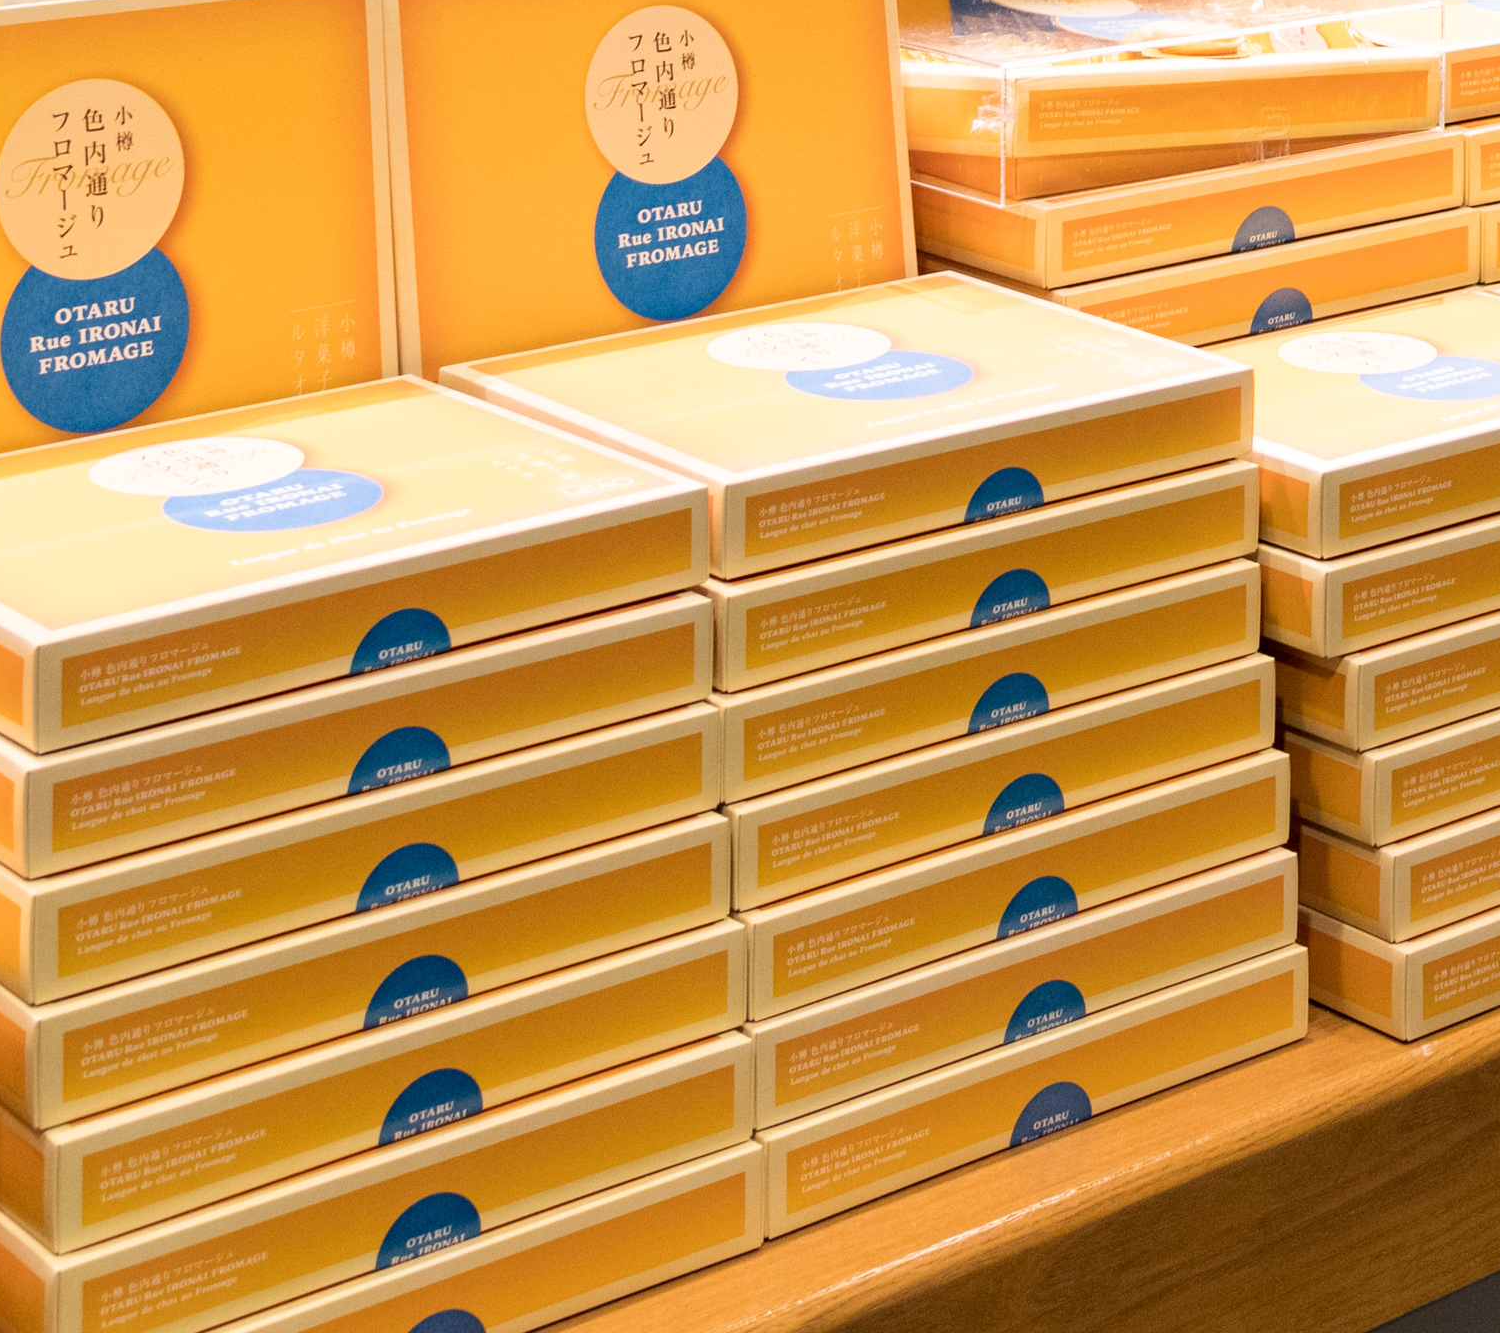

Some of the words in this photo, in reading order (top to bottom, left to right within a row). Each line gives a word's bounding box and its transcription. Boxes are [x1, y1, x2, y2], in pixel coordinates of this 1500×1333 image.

[679, 29, 697, 72] 小樽
[628, 33, 655, 167] フロマージュ
[652, 31, 678, 140] 色内通り
[113, 105, 135, 154] 小樽
[50, 109, 79, 260] フロマージュ
[80, 107, 110, 231] 色内通り
[636, 199, 703, 225] OTARU
[617, 229, 653, 249] Rue
[657, 216, 726, 244] IRONAI
[625, 240, 720, 269] FROMAGE
[54, 296, 136, 326] OTARU
[29, 331, 72, 354] Rue
[78, 315, 163, 344] IRONAI
[37, 340, 155, 376] FROMAGE
[986, 495, 1023, 512] OTARU
[378, 638, 424, 662] OTARU
[1004, 801, 1043, 820] OTARU
[408, 1100, 456, 1124] OTARU
